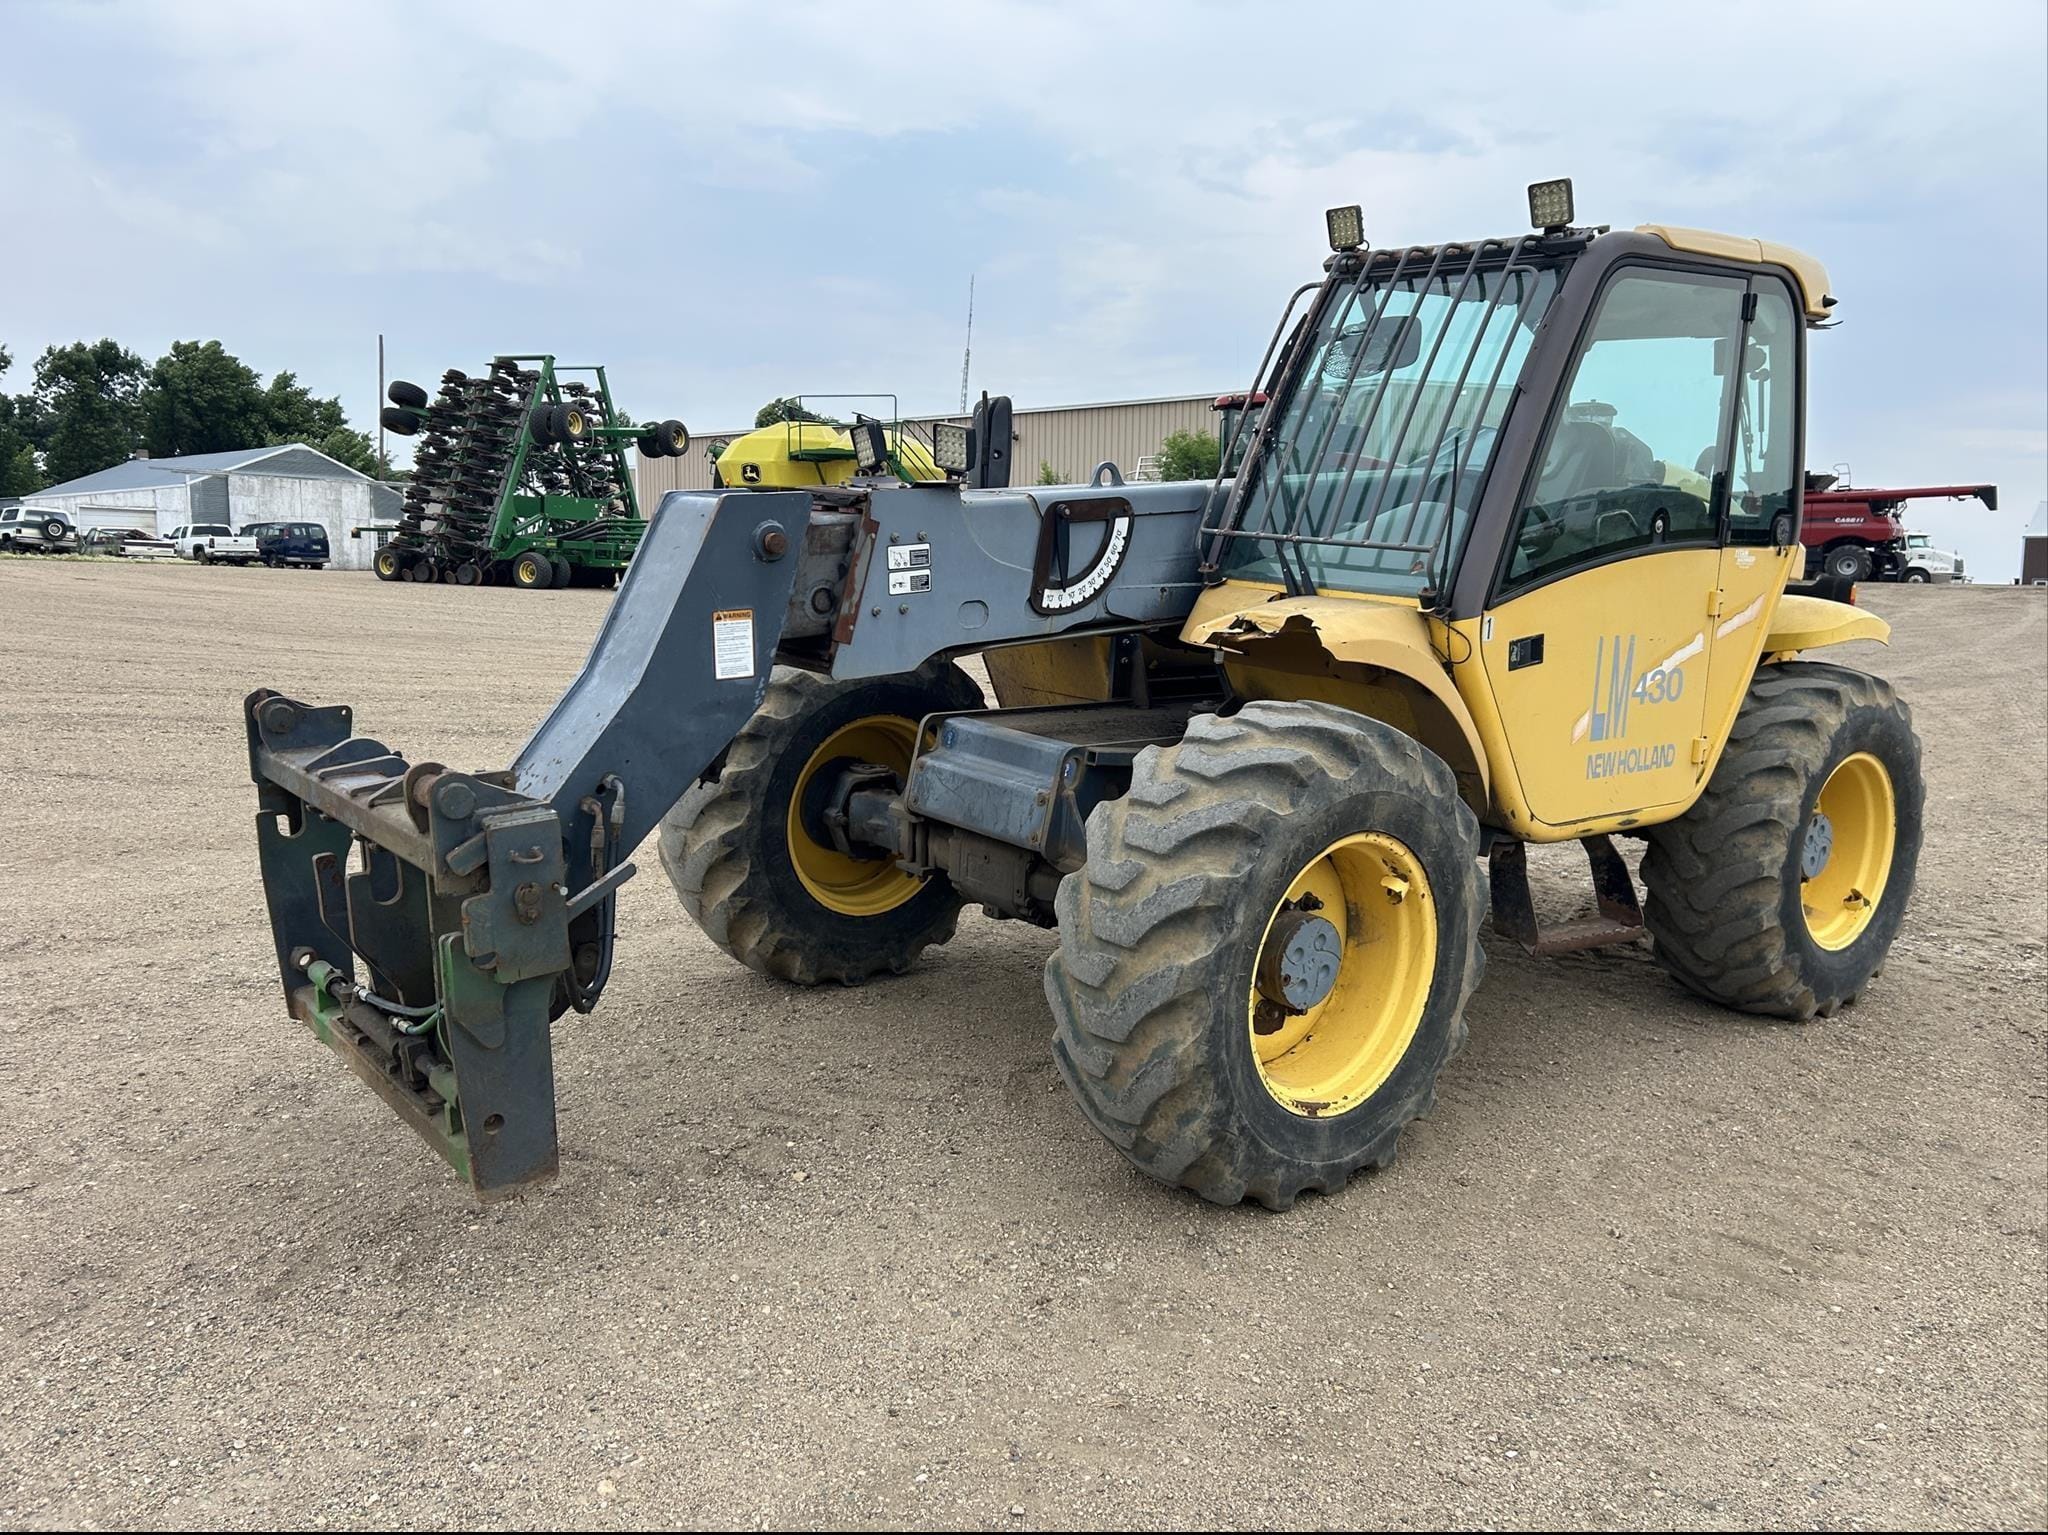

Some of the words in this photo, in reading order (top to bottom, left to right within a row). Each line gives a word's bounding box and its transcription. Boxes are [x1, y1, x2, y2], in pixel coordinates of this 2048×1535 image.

[1590, 635, 1635, 742] LM
[1632, 668, 1684, 705] 430
[1586, 751, 1617, 780] NEW
[1617, 743, 1676, 775] HOLLAND
